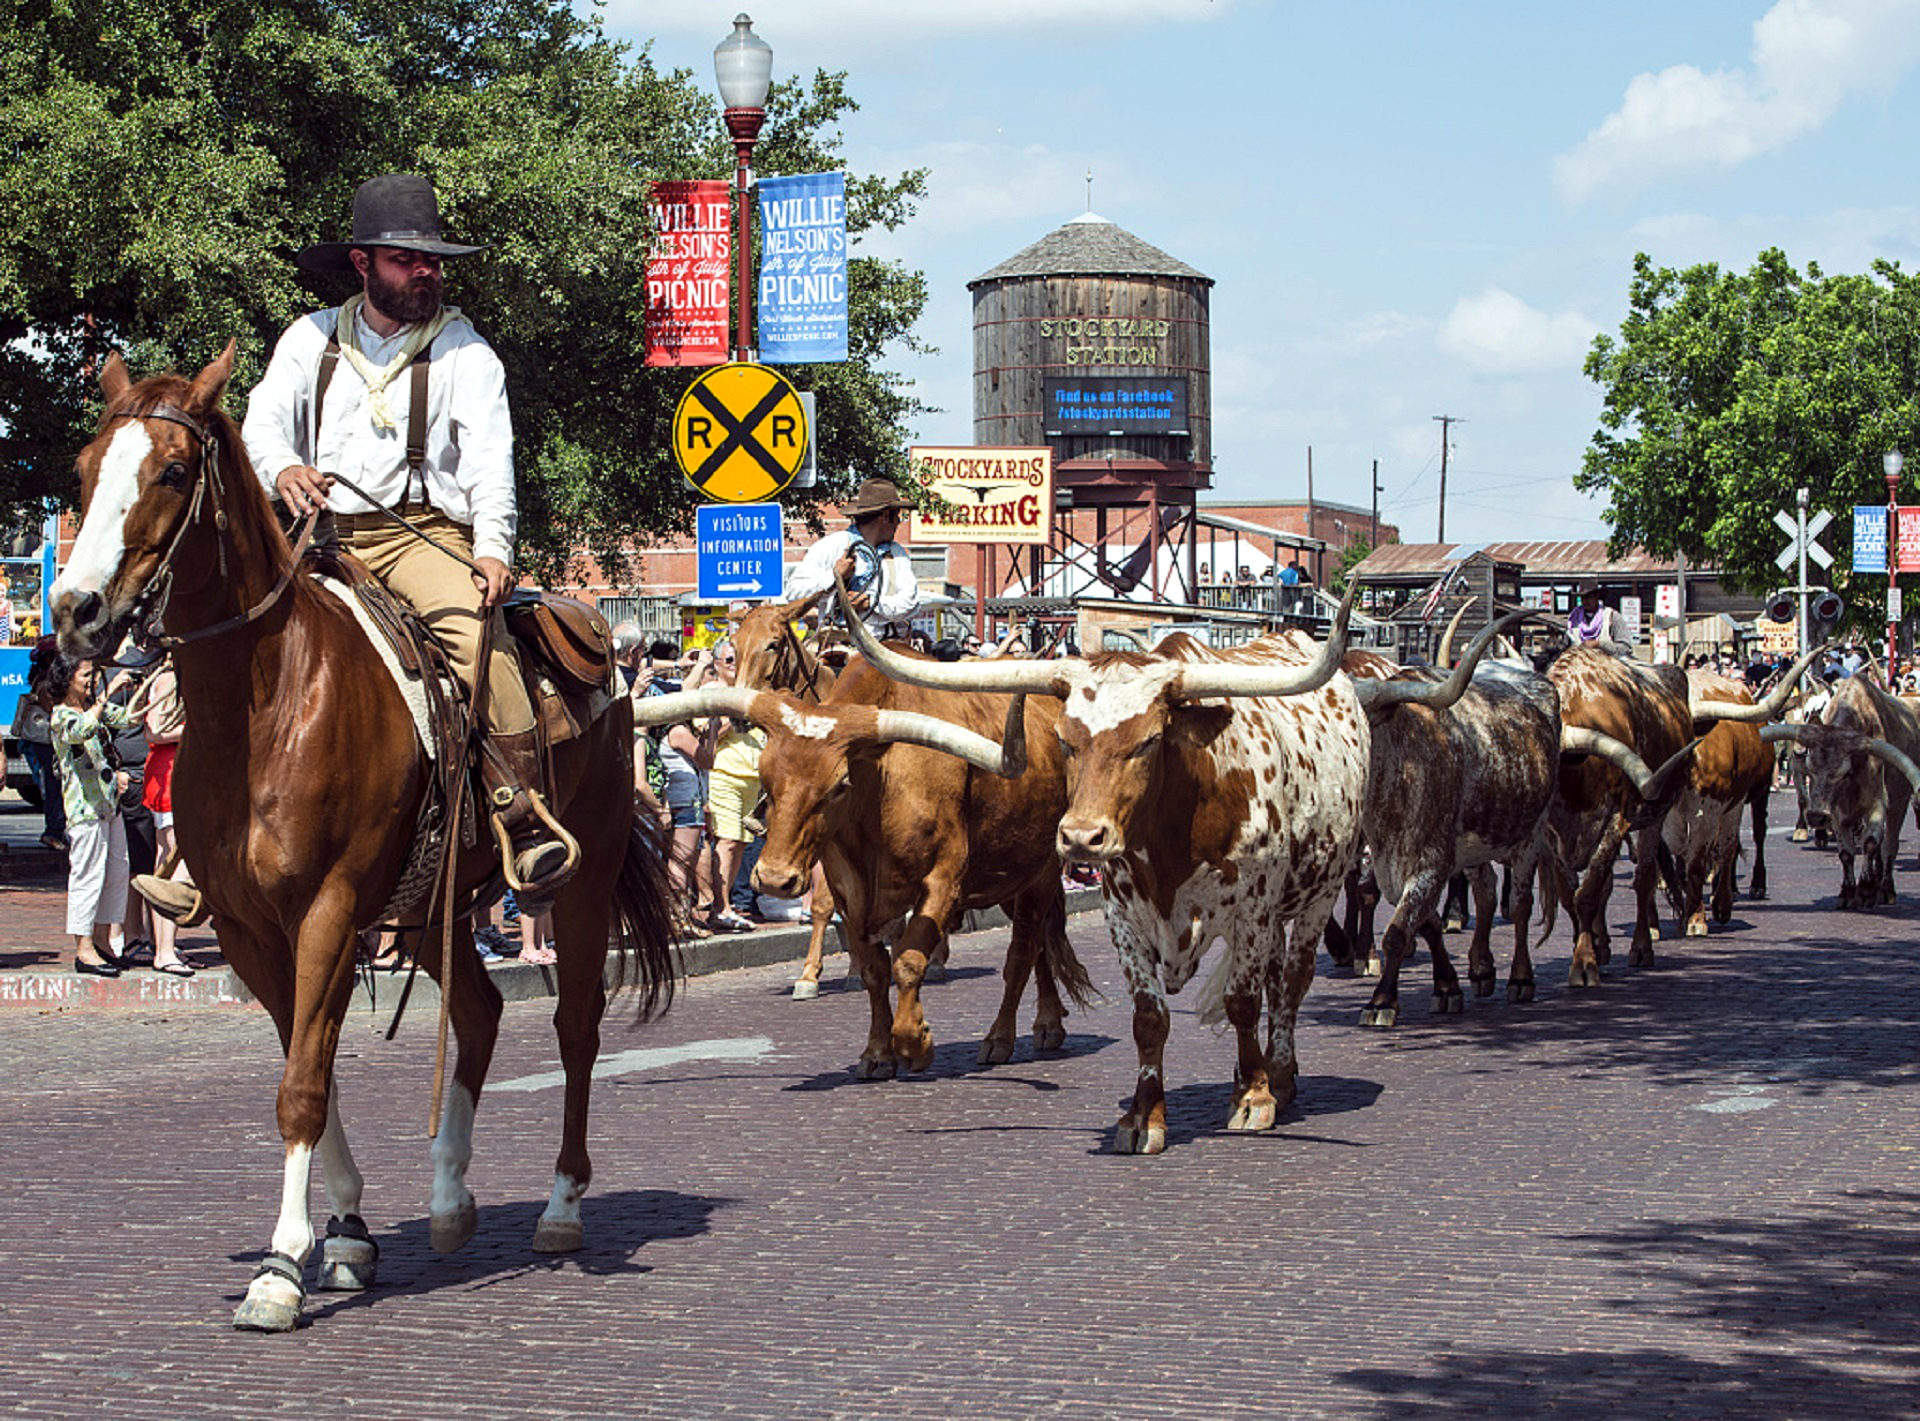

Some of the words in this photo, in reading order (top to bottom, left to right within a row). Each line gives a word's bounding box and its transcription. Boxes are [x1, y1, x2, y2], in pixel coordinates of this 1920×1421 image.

[647, 203, 729, 232] WILLIE
[763, 195, 844, 230] WILLIE
[766, 228, 843, 256] NELSON'S
[648, 279, 727, 309] PICNIC
[761, 273, 844, 306] PICNIC
[1040, 318, 1171, 337] STOCKYARD
[1066, 346, 1158, 365] STATION
[1056, 389, 1081, 403] Find
[1083, 391, 1097, 403] us
[1100, 391, 1115, 403] on
[687, 416, 712, 449] R
[772, 415, 796, 448] R
[919, 456, 1044, 487] STOCKYARDS
[920, 494, 1041, 526] ARKING
[712, 516, 768, 533] VISITORS
[702, 538, 779, 554] INFORMATION
[717, 561, 762, 576] CENTER
